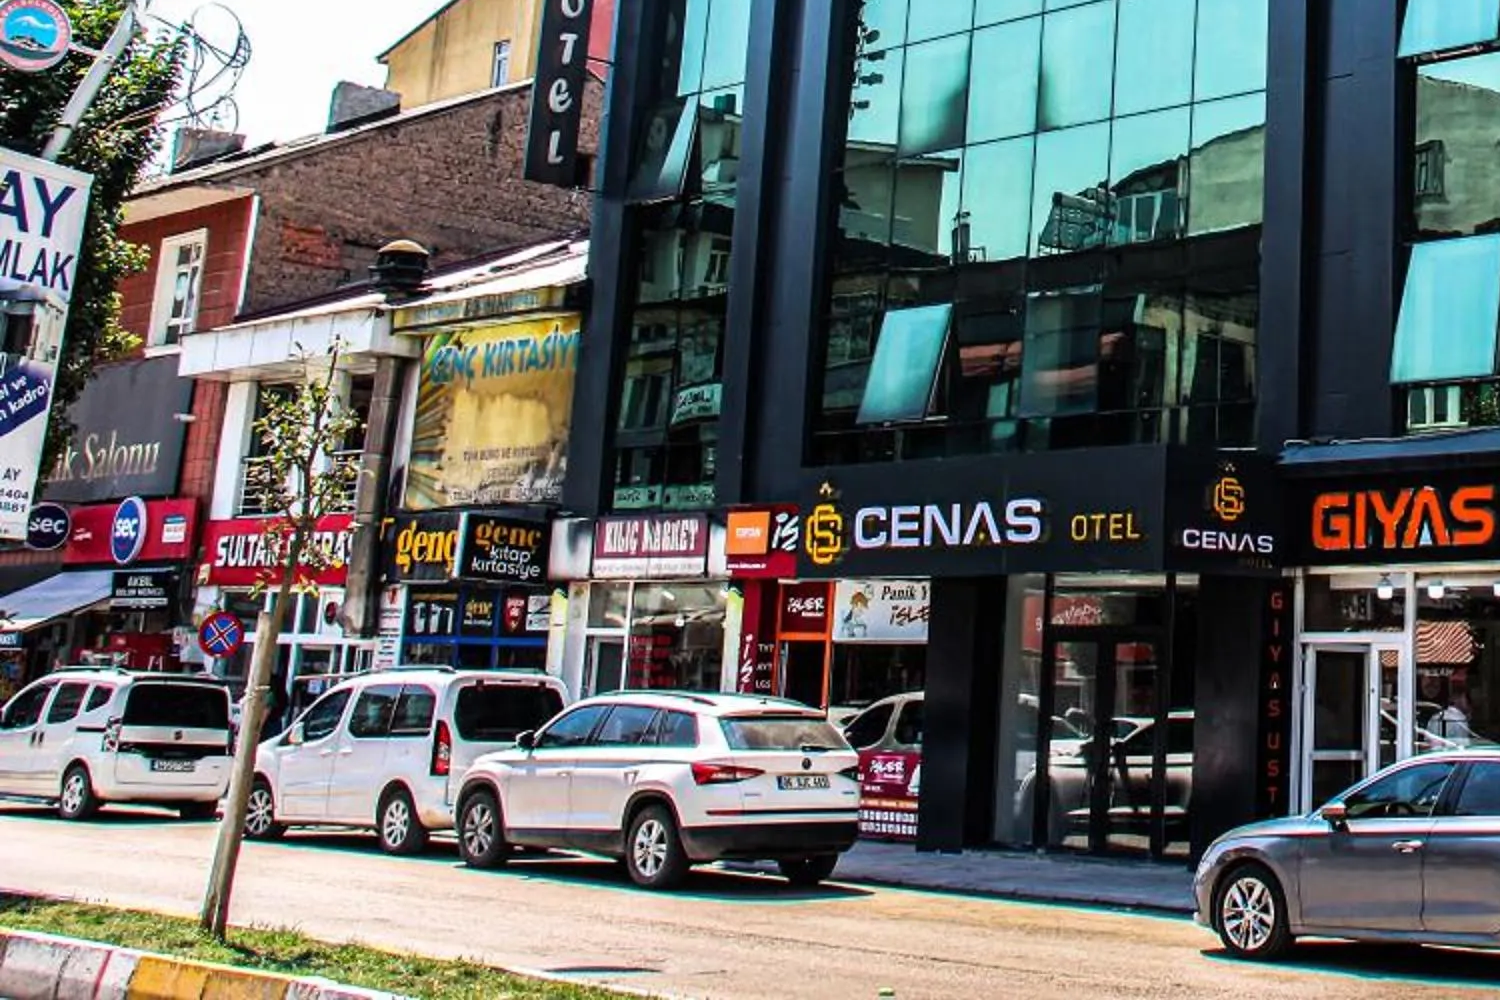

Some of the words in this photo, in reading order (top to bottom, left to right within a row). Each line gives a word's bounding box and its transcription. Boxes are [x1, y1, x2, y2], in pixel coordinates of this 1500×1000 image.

[28, 516, 66, 534] sec
[114, 517, 138, 539] sec
[854, 498, 1042, 549] CENAS
[1071, 513, 1141, 541] OTEL
[1312, 484, 1496, 551] GIYAS
[475, 519, 542, 552] genç
[1182, 528, 1275, 553] CENAS
[1267, 732, 1280, 814] UST
